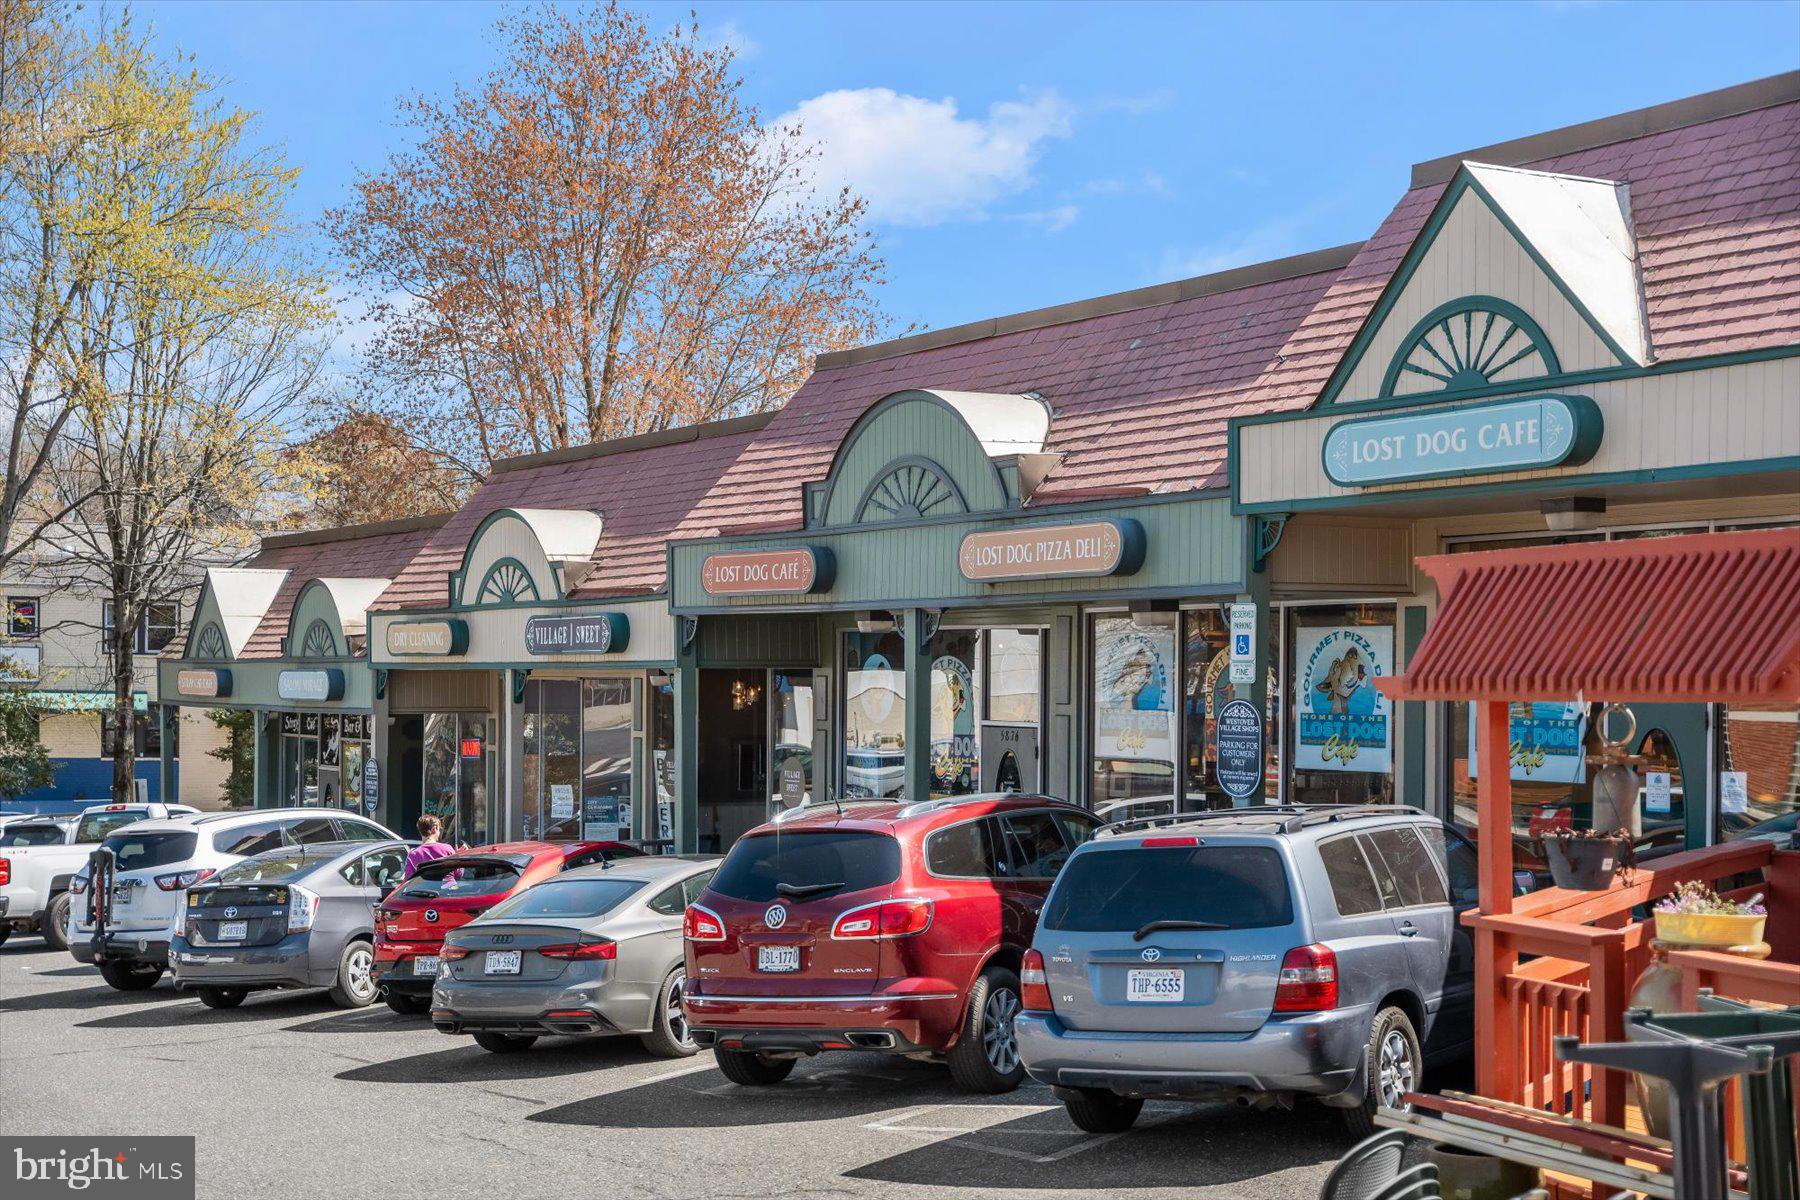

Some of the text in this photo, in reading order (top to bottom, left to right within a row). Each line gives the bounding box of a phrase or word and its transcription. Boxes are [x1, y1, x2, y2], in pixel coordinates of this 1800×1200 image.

[1353, 419, 1539, 464] LOST DOG CAFE
[976, 537, 1101, 566] LOST DOG PIZZA DELI
[715, 557, 799, 583] LOST DOG CAFÉ
[1232, 610, 1254, 618] RESERVED
[394, 631, 444, 648] DRY CLEANING
[535, 625, 600, 645] VILLAGE SWEET
[1235, 668, 1249, 676] FINE
[1304, 631, 1340, 707] GOURMET
[1344, 631, 1376, 663] PIZZA
[1206, 654, 1225, 714] GOURMET
[344, 718, 354, 733] Bar
[1225, 718, 1255, 726] WESTOVER
[1242, 725, 1260, 733] SHOPS
[1301, 721, 1385, 739] LOST DOG
[1000, 730, 1019, 742] 5876
[1533, 727, 1578, 746] DOG
[1220, 741, 1259, 750] PARKING FOR
[1222, 750, 1256, 758] CUSTOMERS
[1132, 978, 1181, 993] THP-6555
